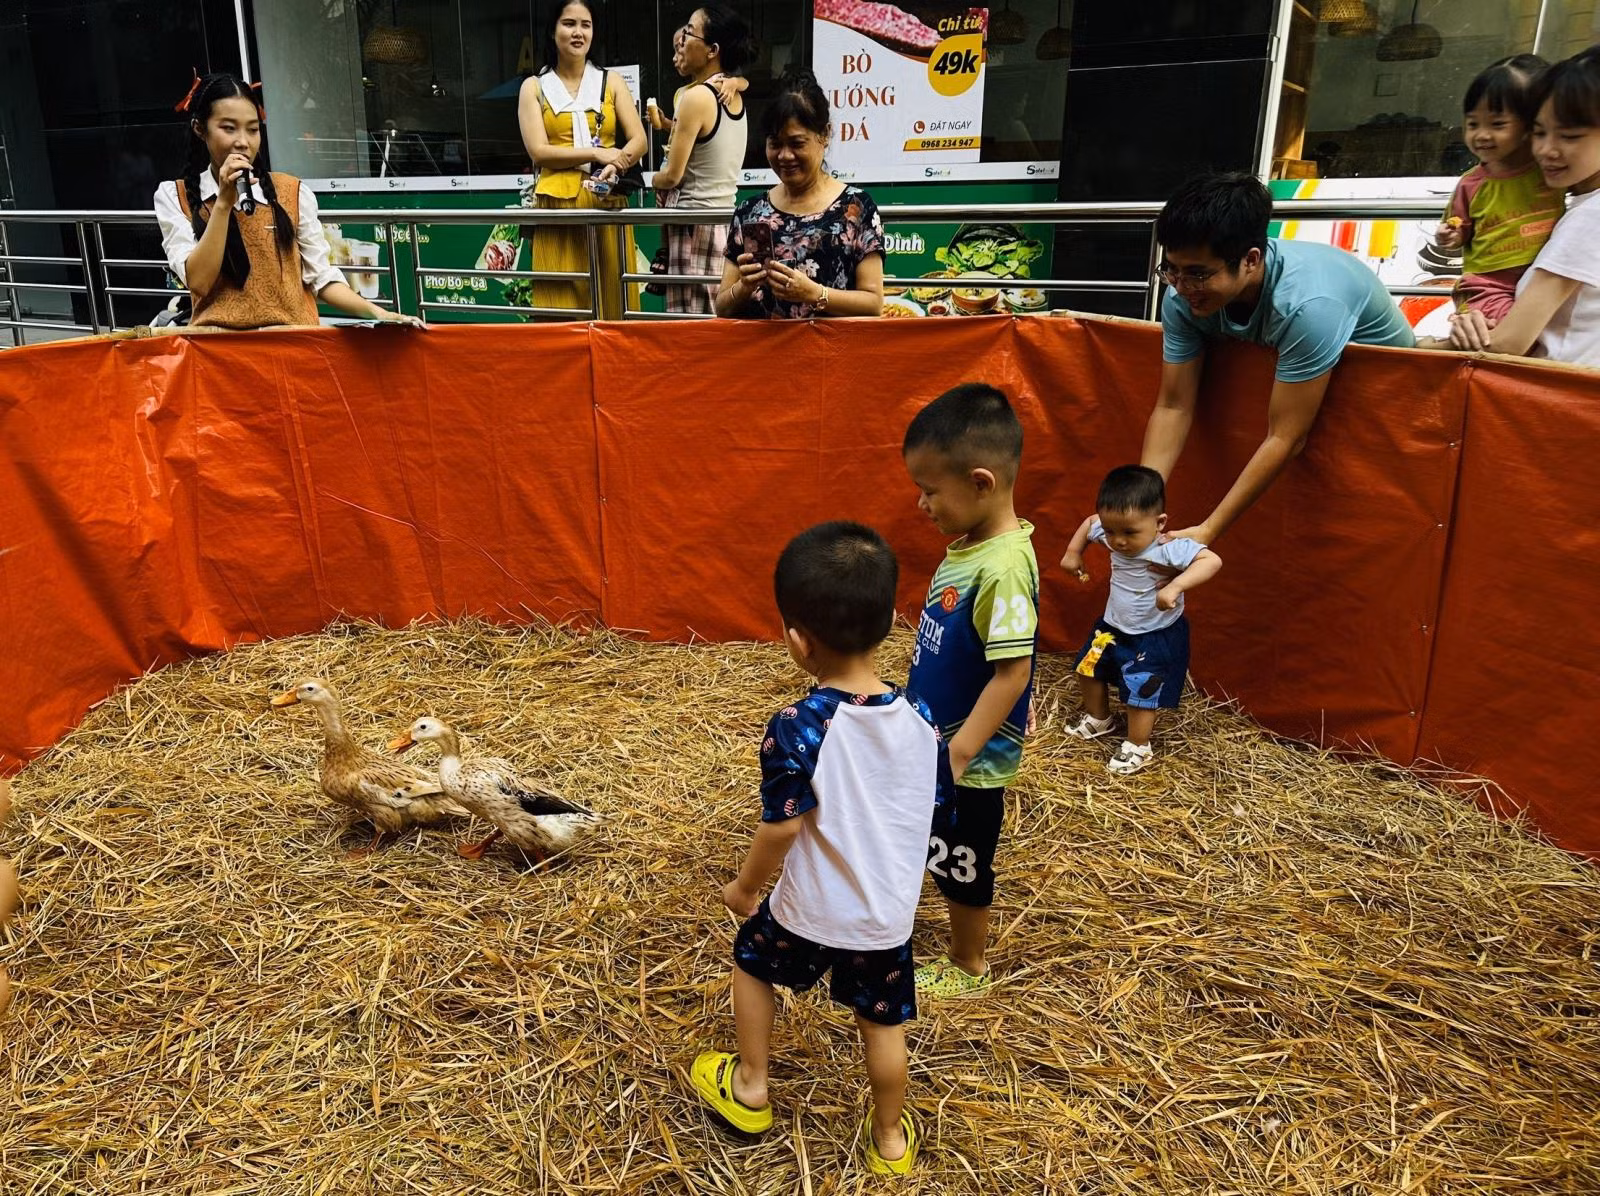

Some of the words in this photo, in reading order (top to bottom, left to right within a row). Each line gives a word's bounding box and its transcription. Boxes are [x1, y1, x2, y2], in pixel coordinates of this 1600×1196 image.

[842, 49, 872, 74] BÒ
[933, 49, 980, 75] 49k
[827, 83, 895, 109] ƯỚNG
[840, 116, 869, 142] ĐÁ
[948, 121, 972, 130] NGAY
[921, 140, 940, 148] 0968
[942, 139, 957, 147] 234
[958, 138, 974, 147] 947
[991, 594, 1030, 636] 23
[922, 637, 940, 655] CLUB
[926, 835, 977, 883] 23
